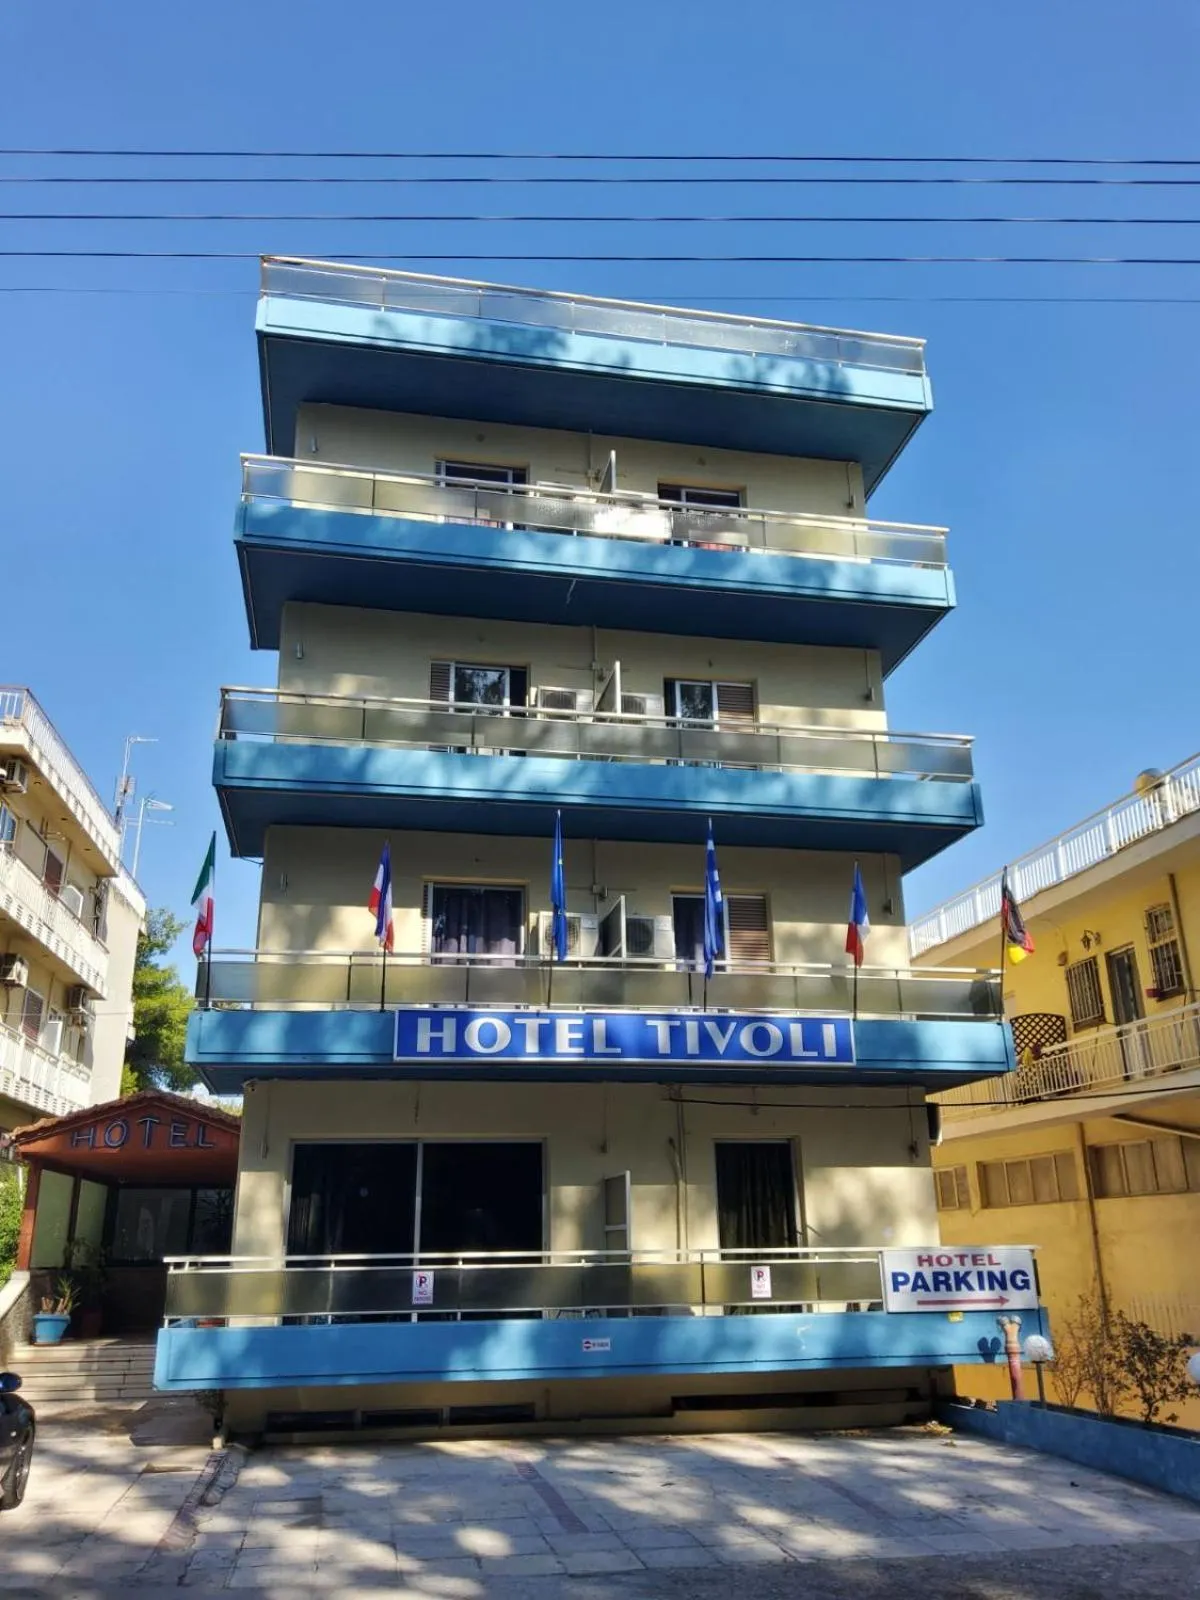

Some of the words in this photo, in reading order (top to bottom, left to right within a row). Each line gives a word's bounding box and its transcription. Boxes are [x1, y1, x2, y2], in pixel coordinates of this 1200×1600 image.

[416, 1017, 622, 1054] HOTEL
[646, 1019, 837, 1057] TIVOLI
[72, 1116, 214, 1148] HOTEL
[917, 1253, 1002, 1267] HOTEL
[891, 1269, 1031, 1293] PARKING
